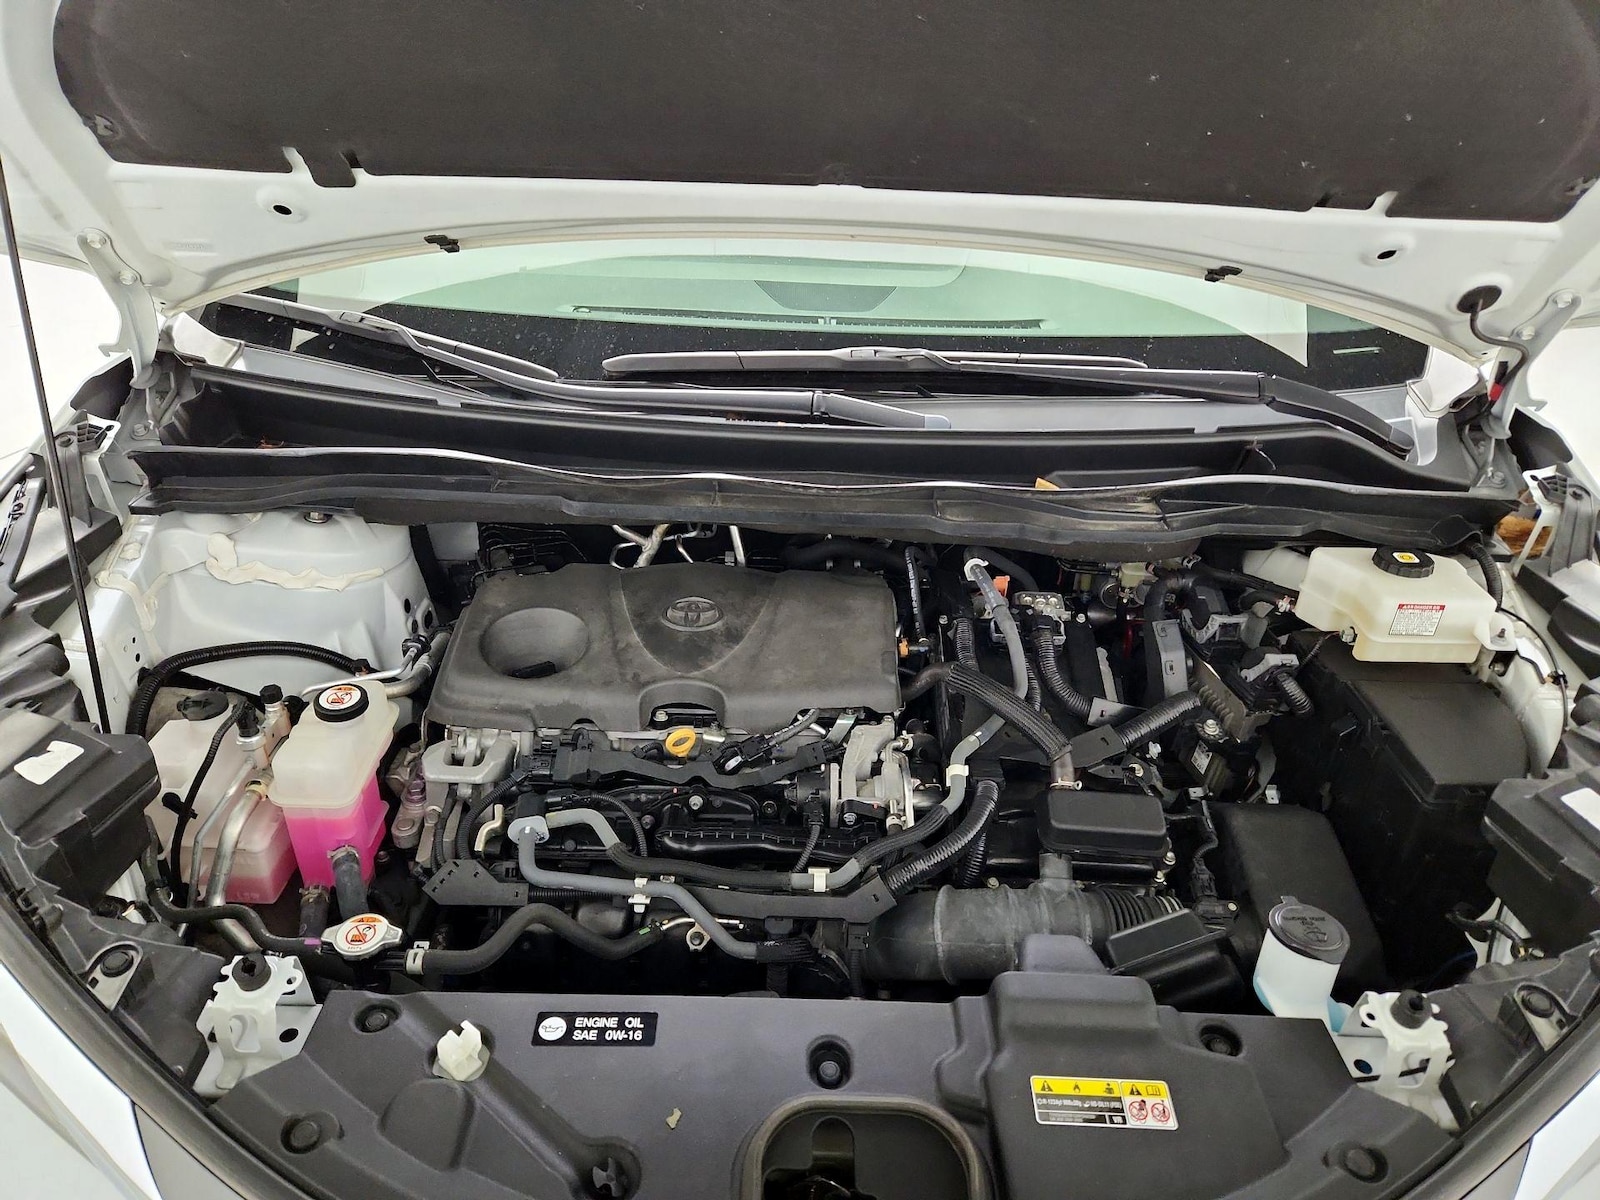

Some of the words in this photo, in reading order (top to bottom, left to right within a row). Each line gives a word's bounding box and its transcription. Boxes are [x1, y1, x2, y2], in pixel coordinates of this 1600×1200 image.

[574, 1016, 618, 1028] ENGINE
[624, 1017, 644, 1028] OIL
[572, 1029, 598, 1041] SAE
[604, 1029, 643, 1041] 0W-16
